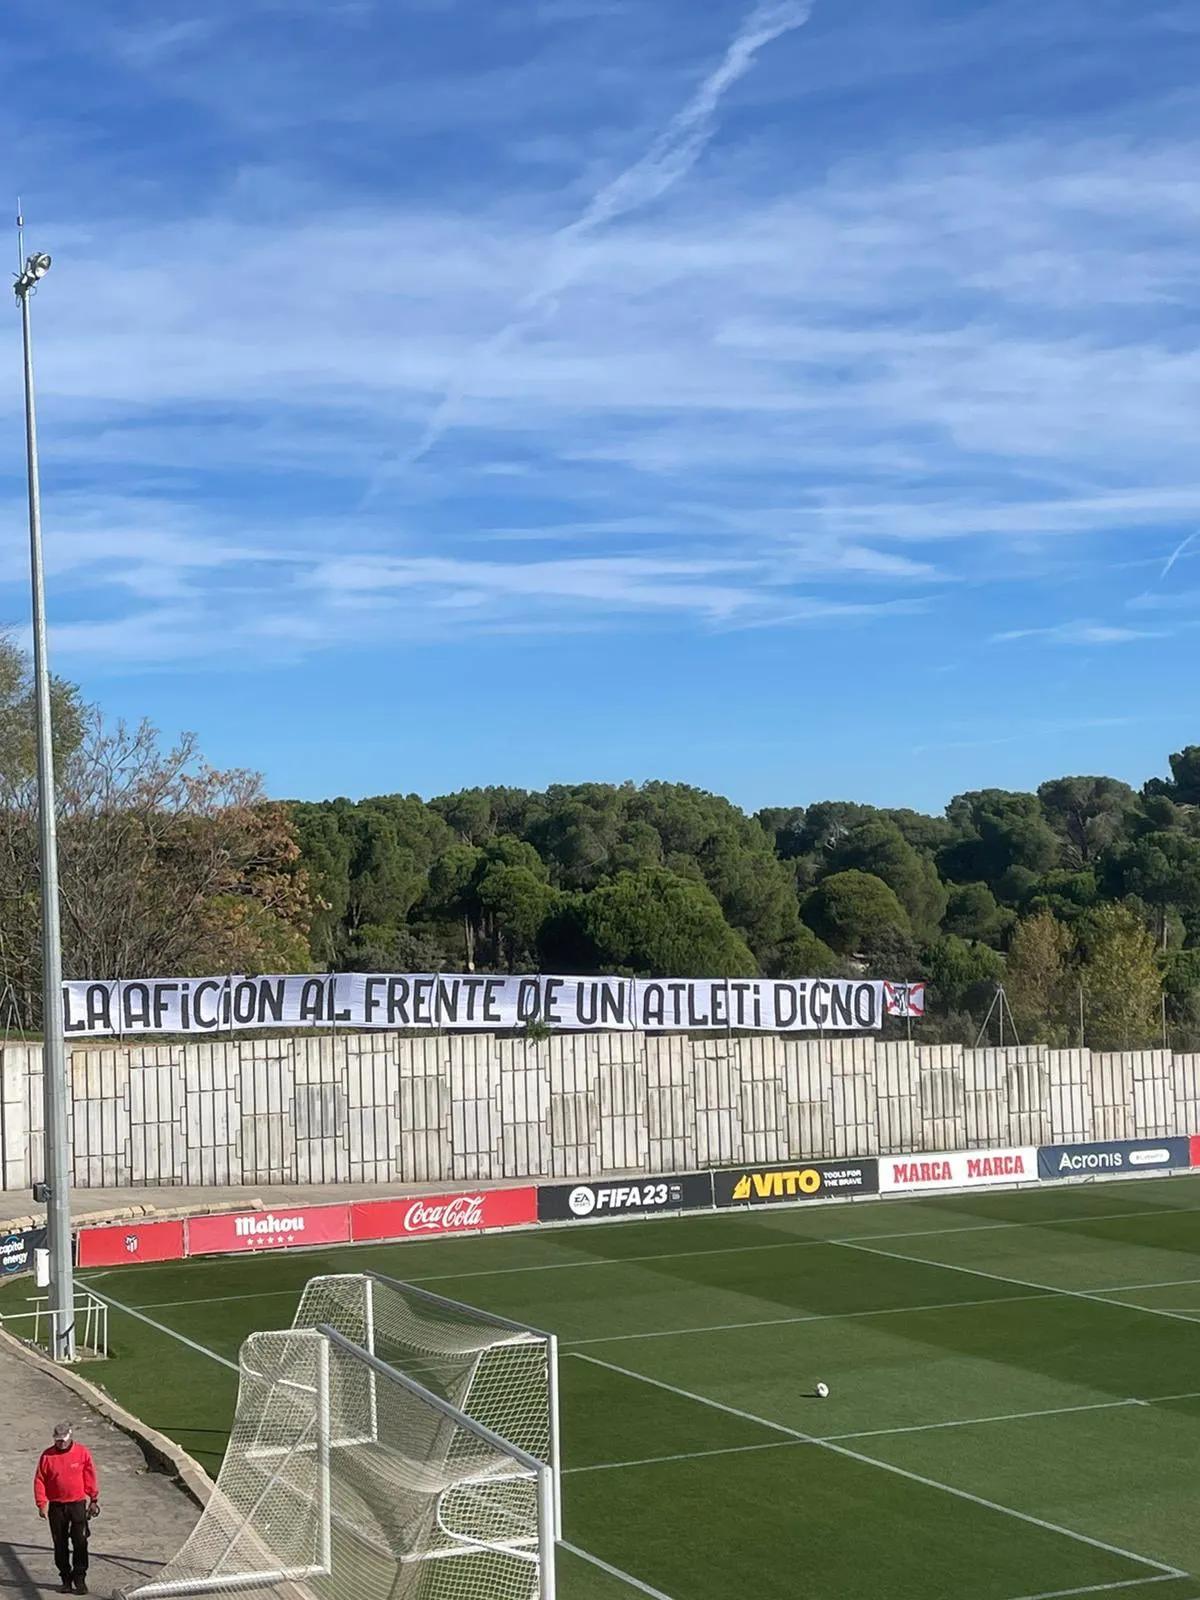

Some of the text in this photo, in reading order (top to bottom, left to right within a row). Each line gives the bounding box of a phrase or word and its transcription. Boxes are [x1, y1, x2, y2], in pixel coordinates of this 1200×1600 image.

[62, 983, 111, 1032] LA
[300, 978, 351, 1021] AL
[365, 977, 505, 1024] FRENTE
[517, 979, 564, 1022] DE
[576, 982, 624, 1025] UN
[893, 1155, 1025, 1183] MARCA MARCA
[1058, 1152, 1122, 1171] Acronis
[752, 1169, 820, 1197] VITO
[823, 1169, 862, 1179] TOOLS FOR
[824, 1177, 862, 1187] THE BRAVE
[574, 1193, 590, 1202] EA
[404, 1196, 486, 1232] Coca-Cola
[235, 1214, 305, 1236] Mahou
[3, 1252, 28, 1265] energy
